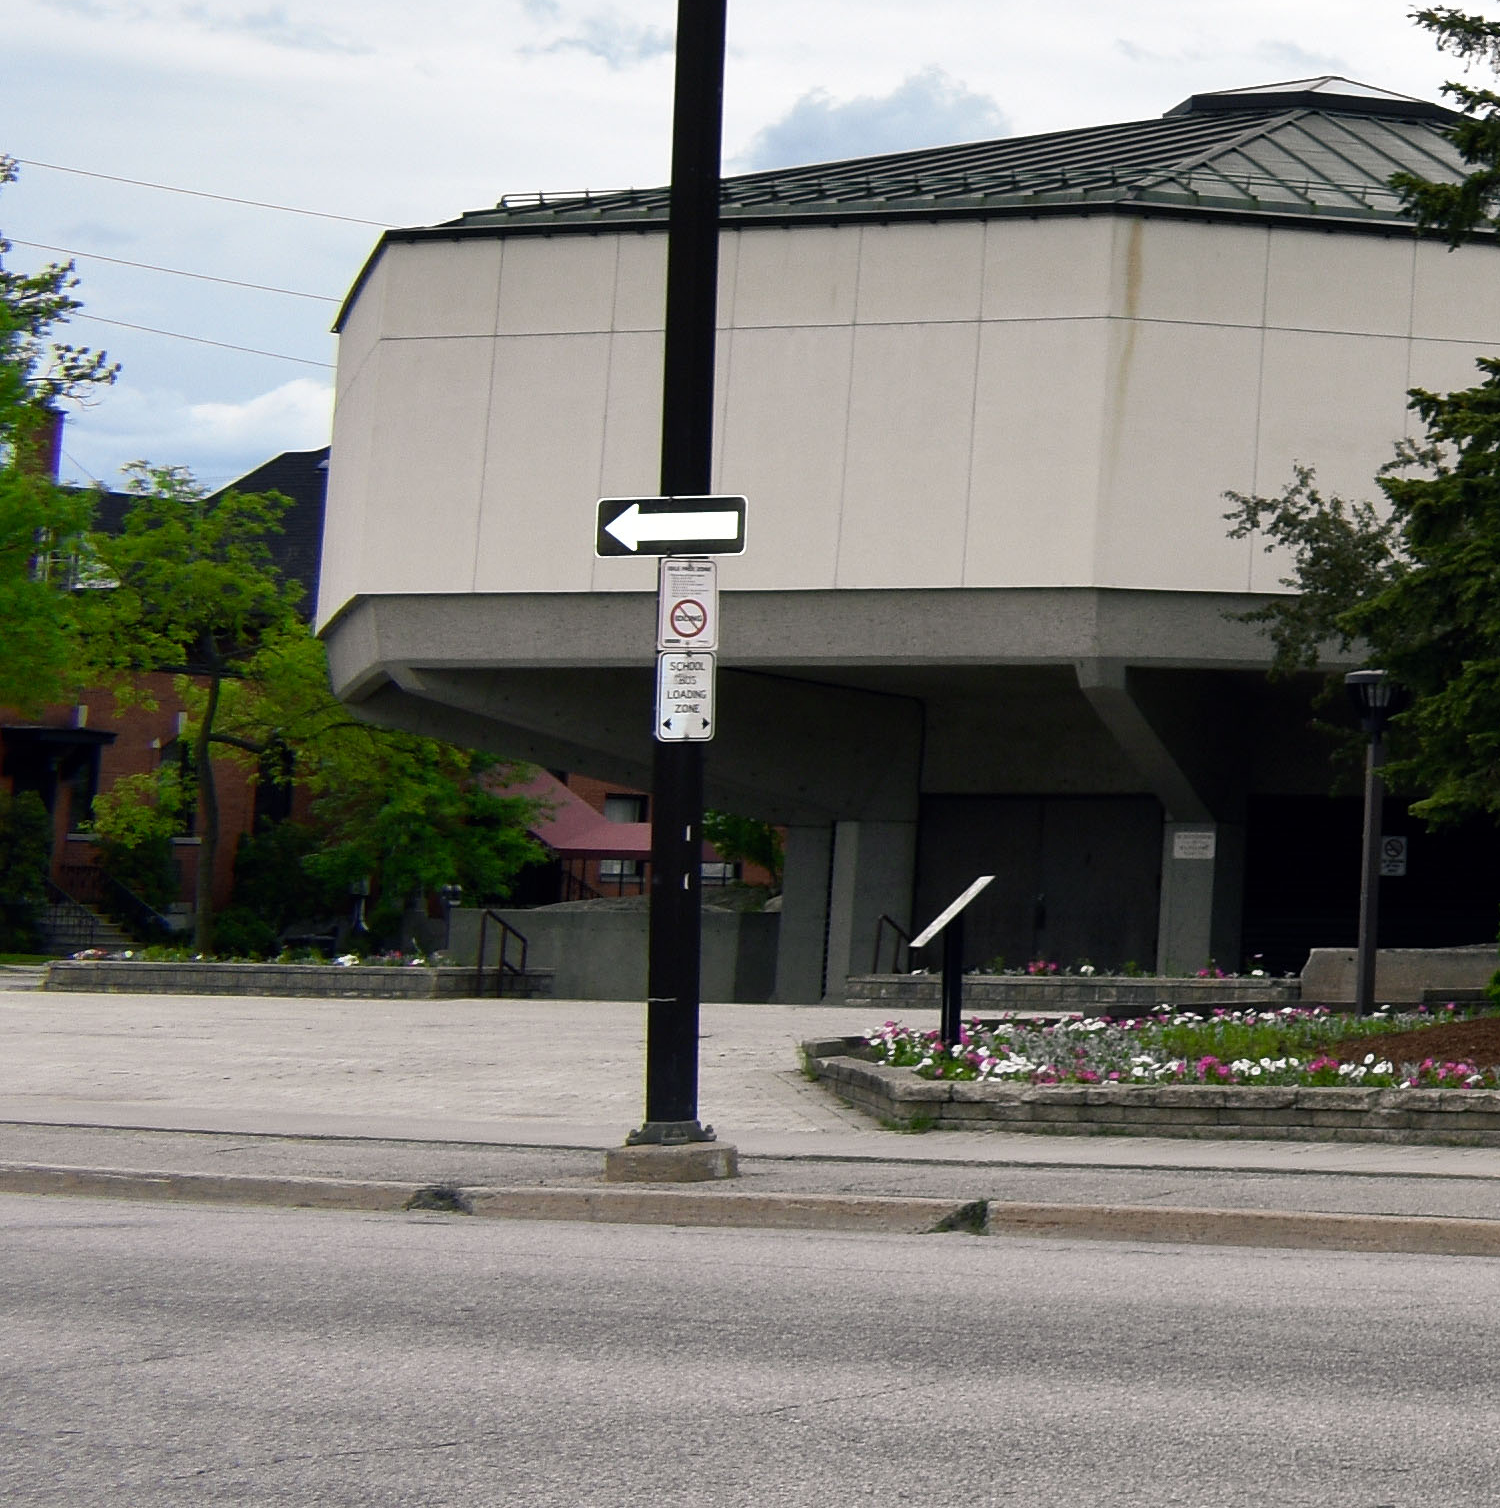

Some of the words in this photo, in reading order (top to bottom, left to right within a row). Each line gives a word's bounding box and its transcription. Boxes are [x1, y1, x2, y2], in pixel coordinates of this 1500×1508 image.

[669, 661, 706, 671] SCHOOL
[667, 689, 707, 699] LOADING
[674, 704, 700, 713] ZONE
